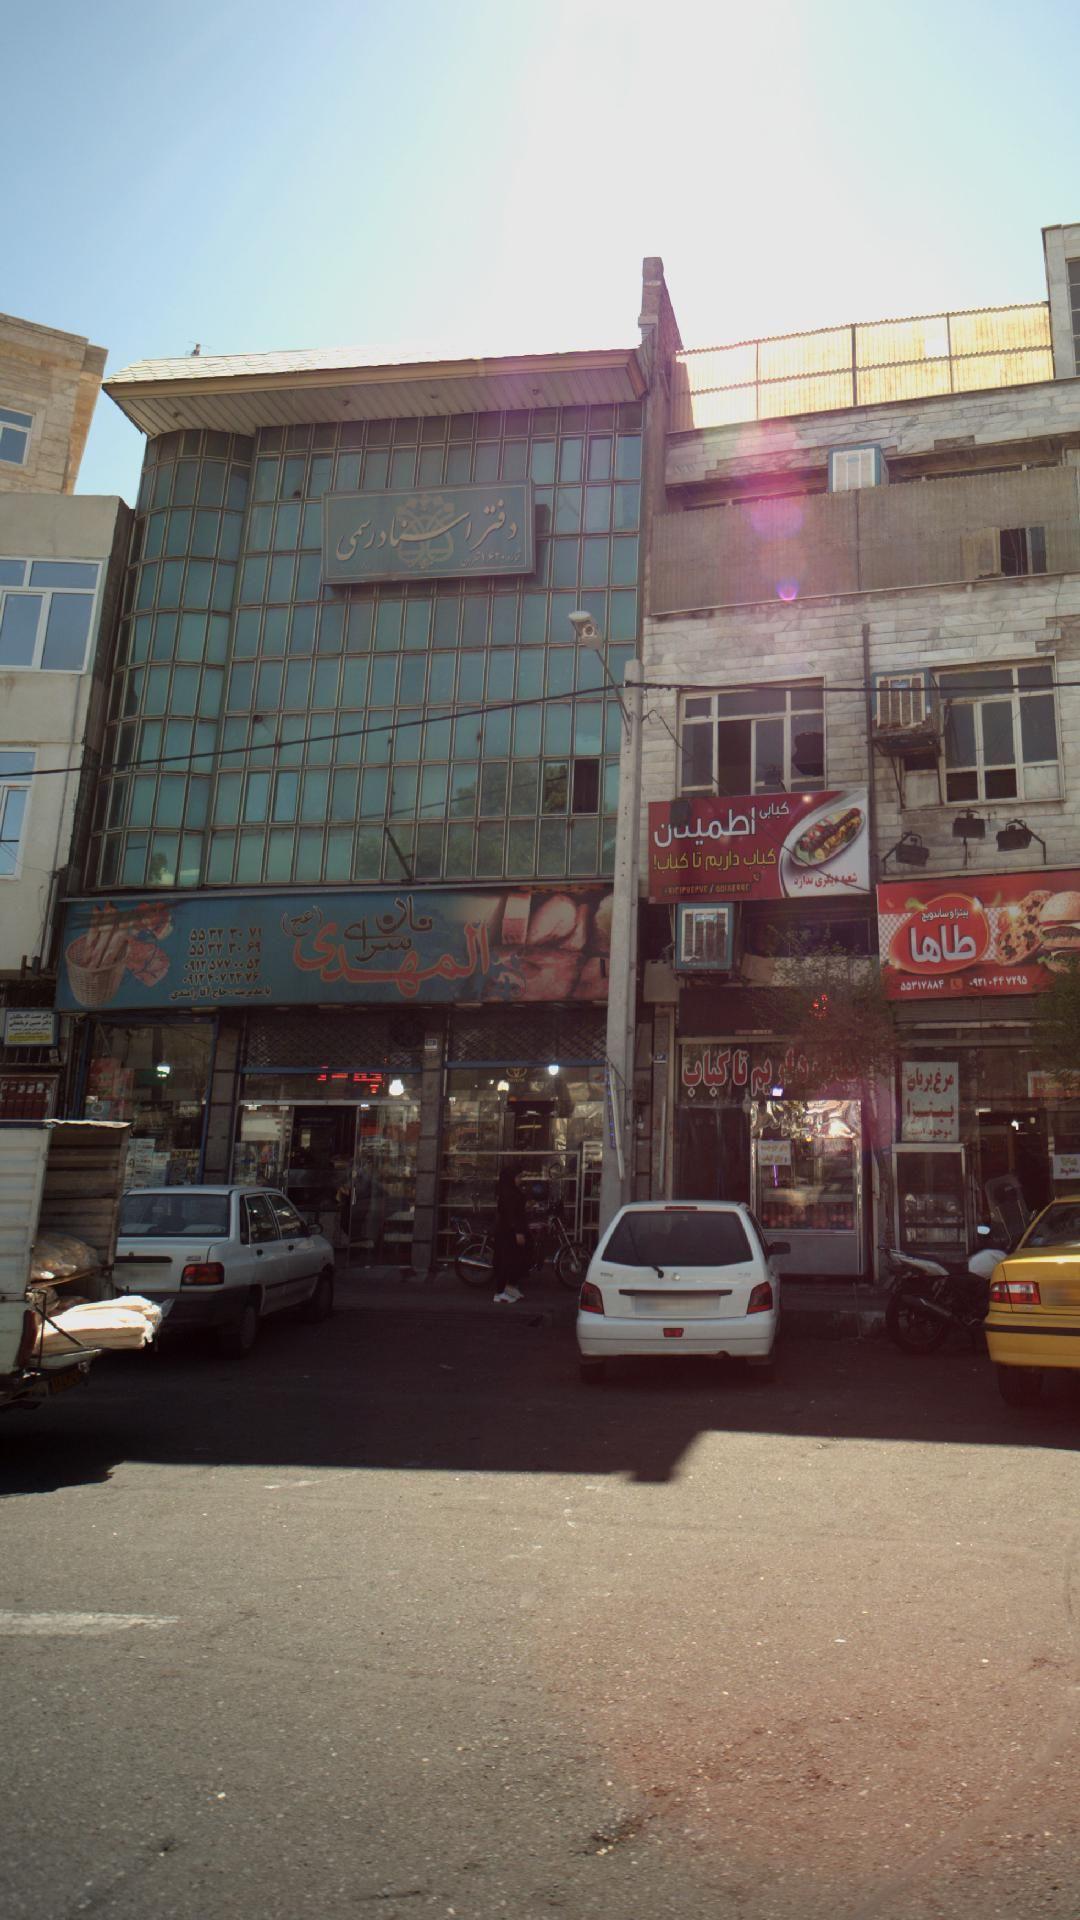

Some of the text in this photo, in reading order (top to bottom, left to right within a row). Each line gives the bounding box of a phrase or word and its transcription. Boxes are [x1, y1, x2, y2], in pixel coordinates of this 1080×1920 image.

[335, 498, 518, 561] دفتر اسناد رسمی
[759, 801, 790, 820] کبابی
[692, 850, 702, 868] تا
[704, 849, 740, 871] داریم
[743, 848, 777, 868] کباب
[376, 895, 433, 934] نان
[343, 918, 412, 962] سرای
[910, 924, 976, 964] طاها
[292, 920, 490, 998] المهدی
[681, 1049, 732, 1098] کباب
[733, 1049, 750, 1086] تا
[907, 1067, 954, 1094] مرغ بریان
[907, 1098, 954, 1124] پیتزا
